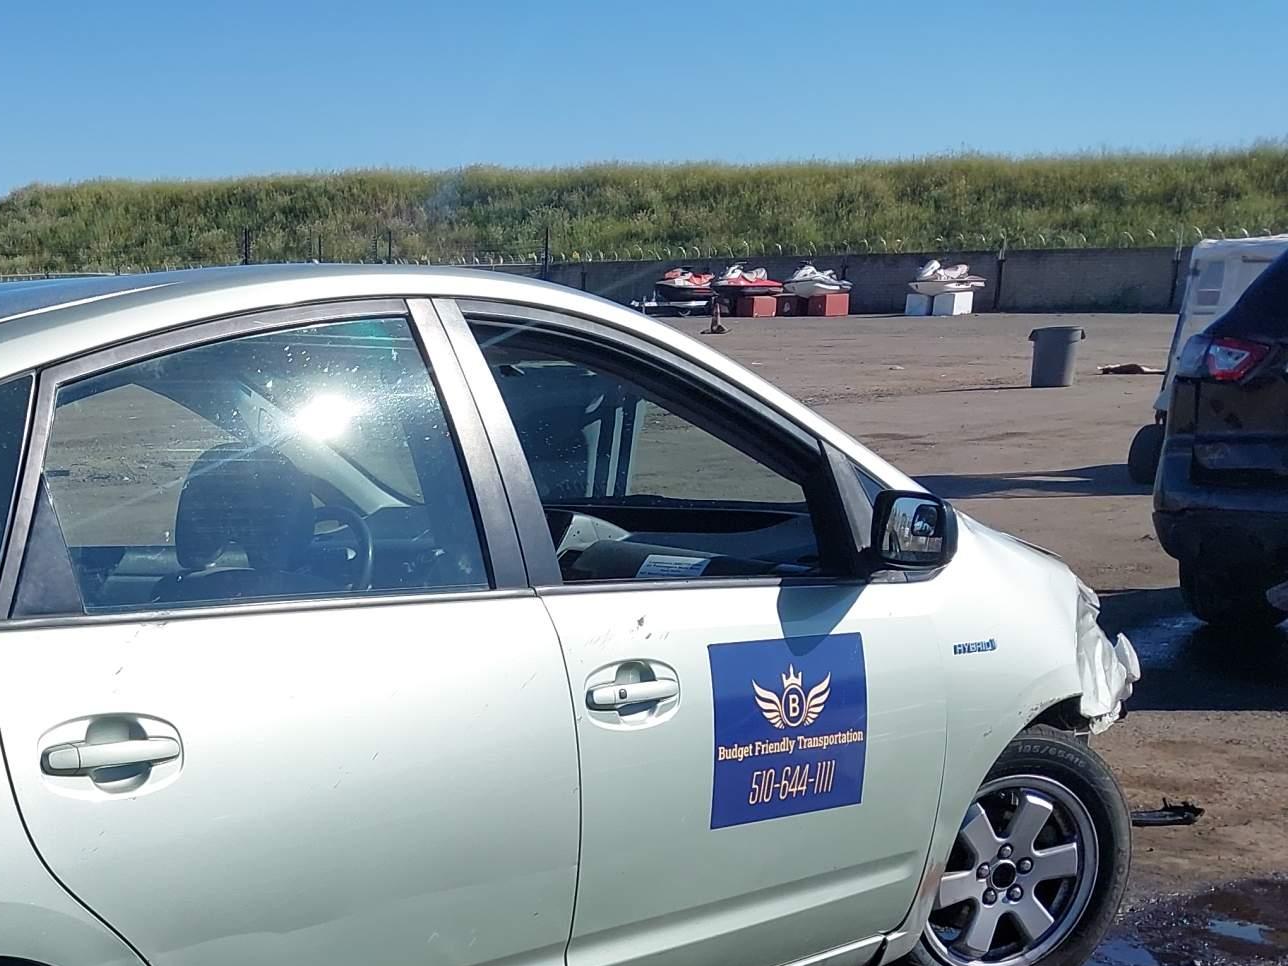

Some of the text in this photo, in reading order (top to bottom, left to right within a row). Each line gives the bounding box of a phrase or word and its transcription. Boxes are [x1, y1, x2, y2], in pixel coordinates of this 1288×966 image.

[953, 638, 996, 655] HYBRID
[789, 694, 800, 717] B
[718, 729, 864, 762] Budget Friendly Transportation
[748, 760, 836, 805] 510-644-1111
